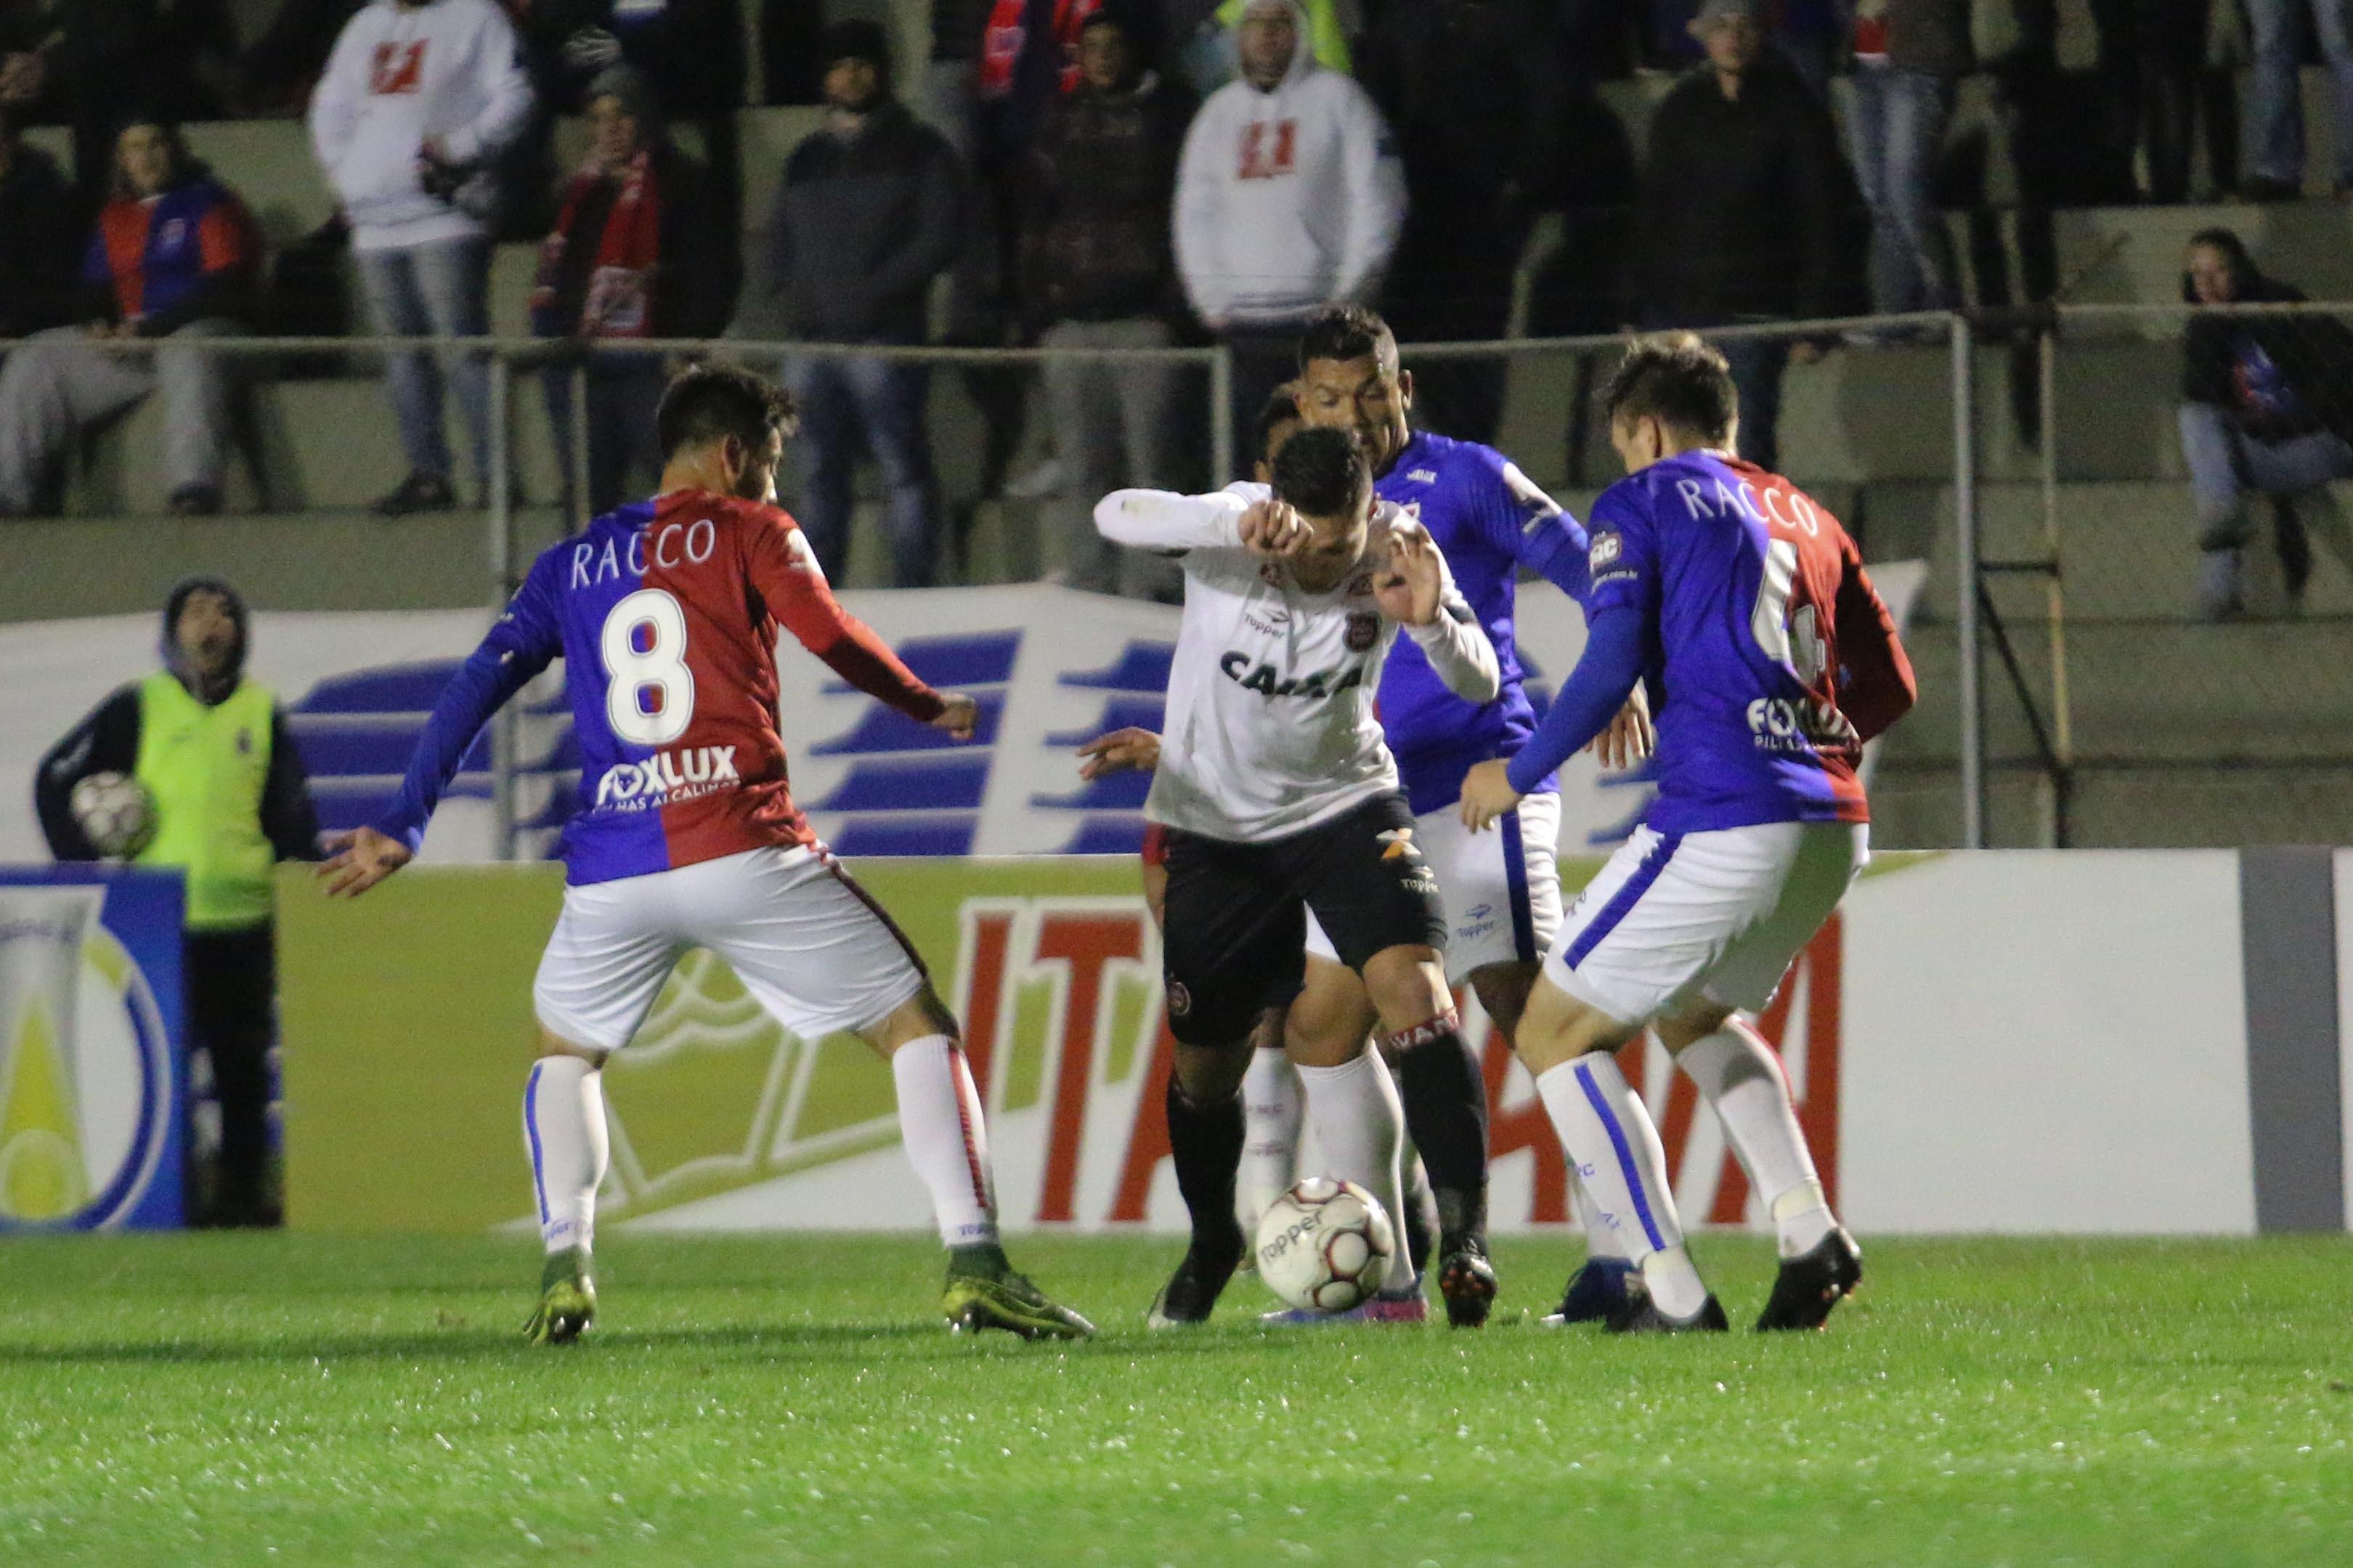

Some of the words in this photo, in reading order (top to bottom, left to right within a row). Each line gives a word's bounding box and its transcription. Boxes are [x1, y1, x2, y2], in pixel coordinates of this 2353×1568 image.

[1675, 478, 1818, 539] RACCO
[570, 519, 715, 590] RACCO
[1243, 614, 1285, 640] Topper
[601, 587, 696, 746] 8
[597, 744, 740, 806] FOXLUX
[1457, 919, 1495, 938] Topper
[1261, 1211, 1322, 1265] Topper
